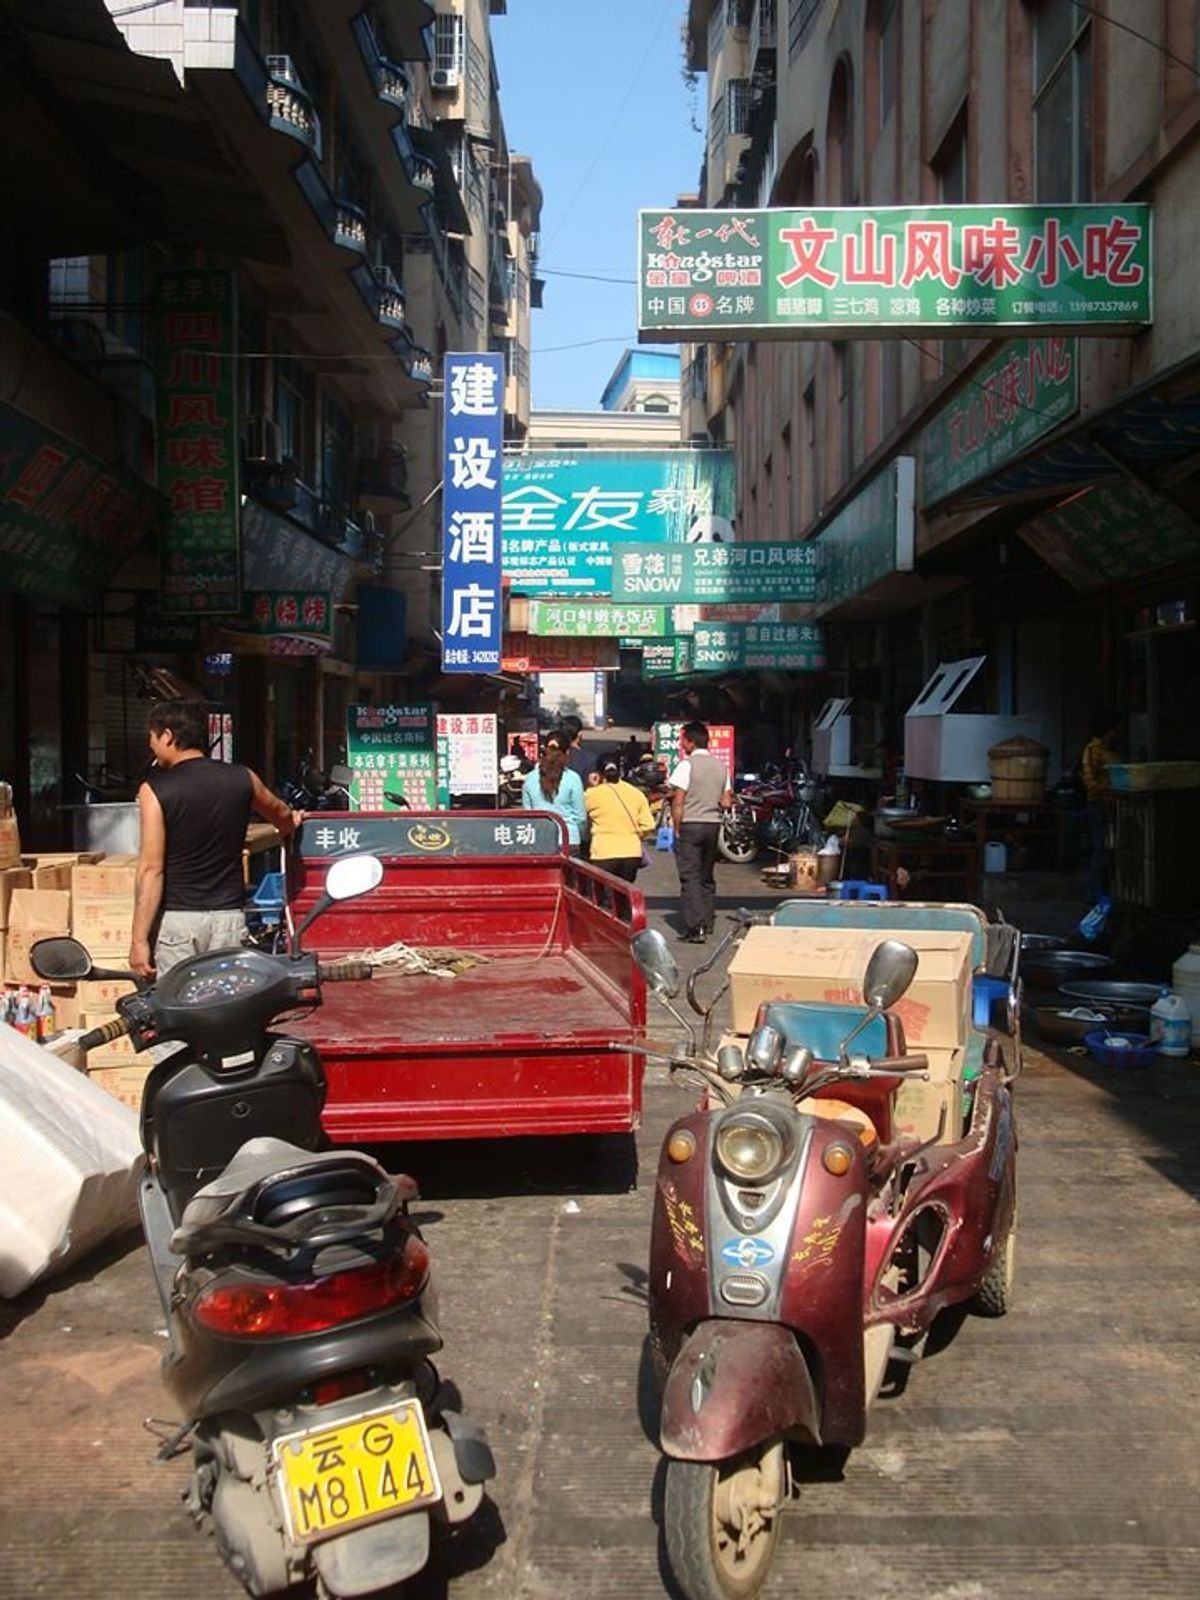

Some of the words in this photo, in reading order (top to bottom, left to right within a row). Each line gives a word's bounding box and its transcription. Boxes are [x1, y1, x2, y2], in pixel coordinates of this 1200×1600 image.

[776, 216, 1145, 290] 文山风味小吃
[648, 296, 685, 315] 中国
[716, 295, 754, 315] 名牌
[935, 297, 997, 317] 各种炒菜
[163, 311, 228, 513] 四川风味馆
[446, 362, 499, 639] 建设酒店
[621, 553, 666, 576] 雪花
[623, 577, 681, 593] SNOW
[694, 630, 727, 647] 雪花
[696, 650, 740, 662] SNOW
[436, 717, 495, 735] 建设酒店
[315, 827, 361, 849] 丰收
[494, 823, 537, 846] 电动
[312, 1435, 346, 1474] 云
[362, 1423, 394, 1457] G
[299, 1451, 425, 1530] M8144
